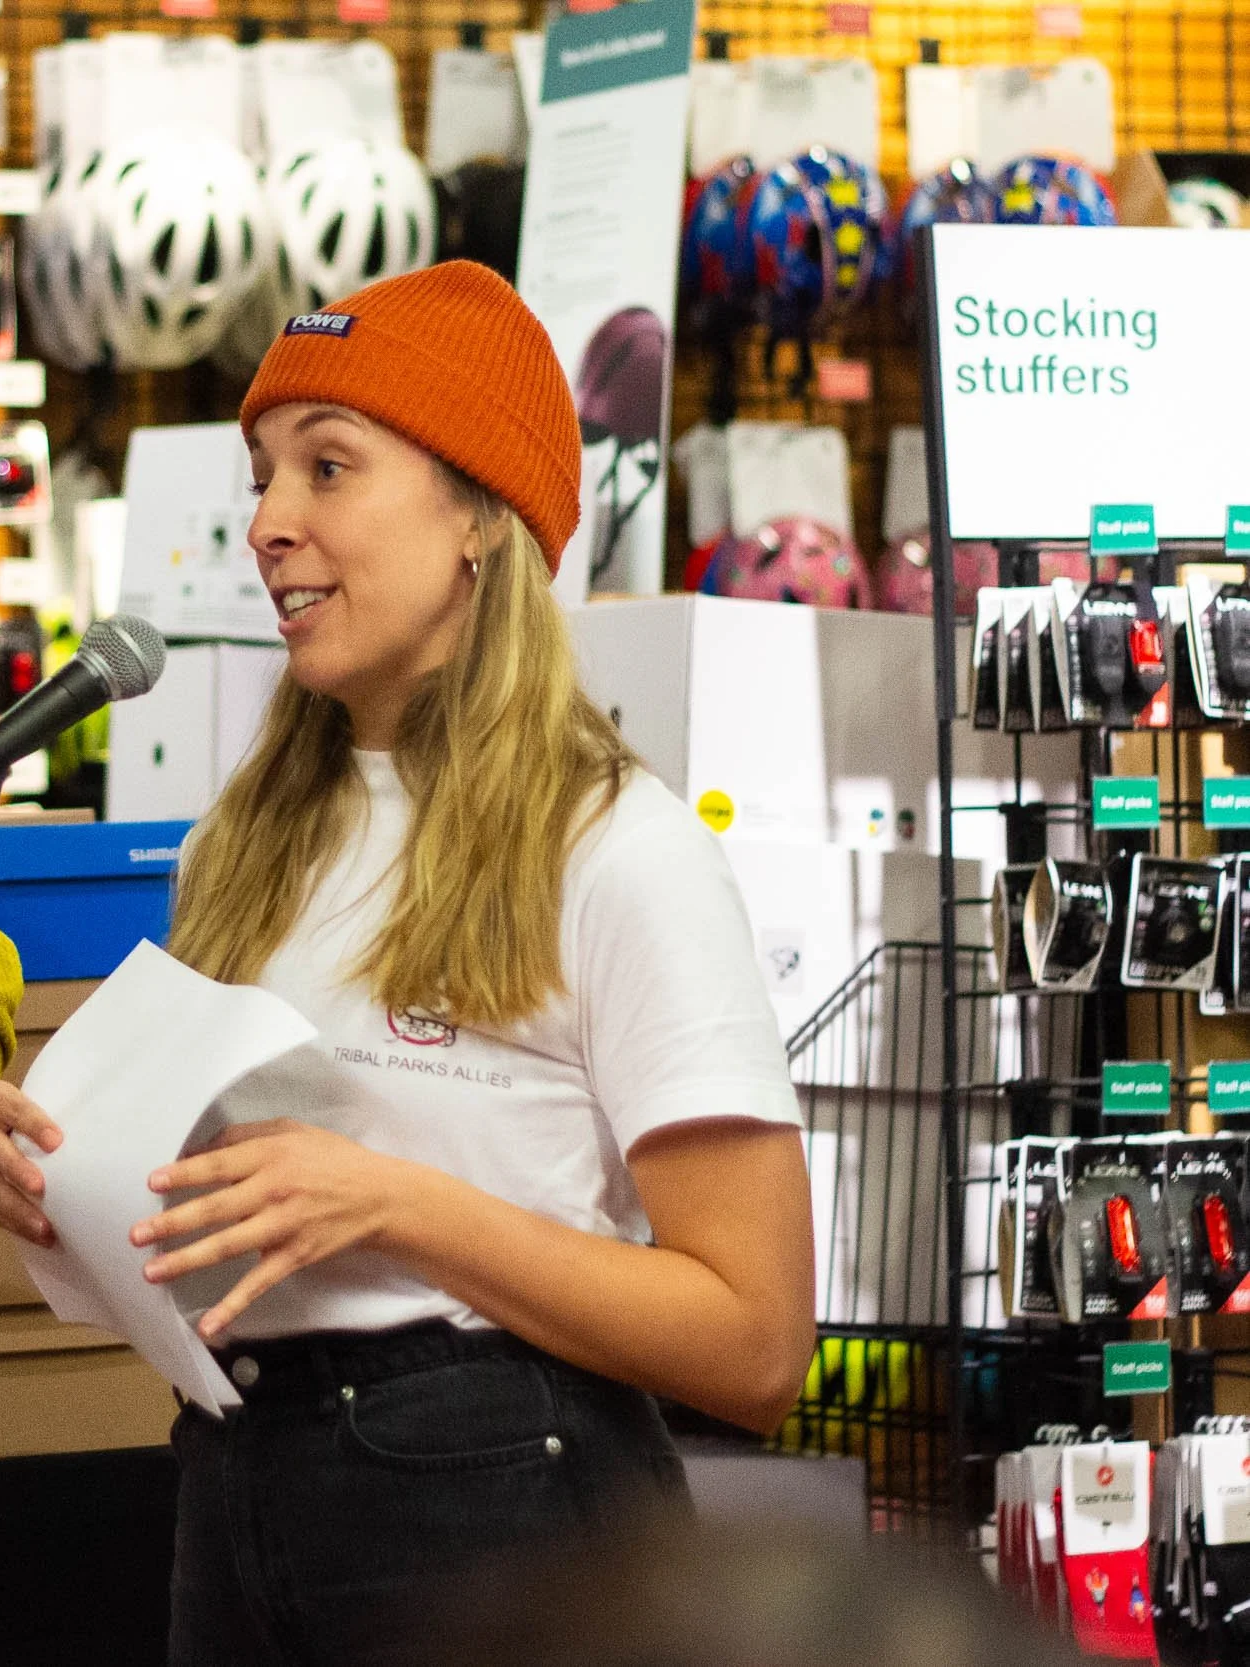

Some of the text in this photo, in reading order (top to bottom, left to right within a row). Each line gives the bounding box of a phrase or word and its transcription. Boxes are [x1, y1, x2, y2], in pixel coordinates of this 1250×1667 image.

[292, 314, 336, 328] POW
[954, 295, 1158, 350] Stocking
[956, 354, 1130, 394] stuffers
[1100, 796, 1124, 809] Staff
[334, 1047, 512, 1090] TRIBAL PARKS ALLIES
[1111, 1082, 1135, 1094] Staff
[1111, 1362, 1136, 1375] Staff
